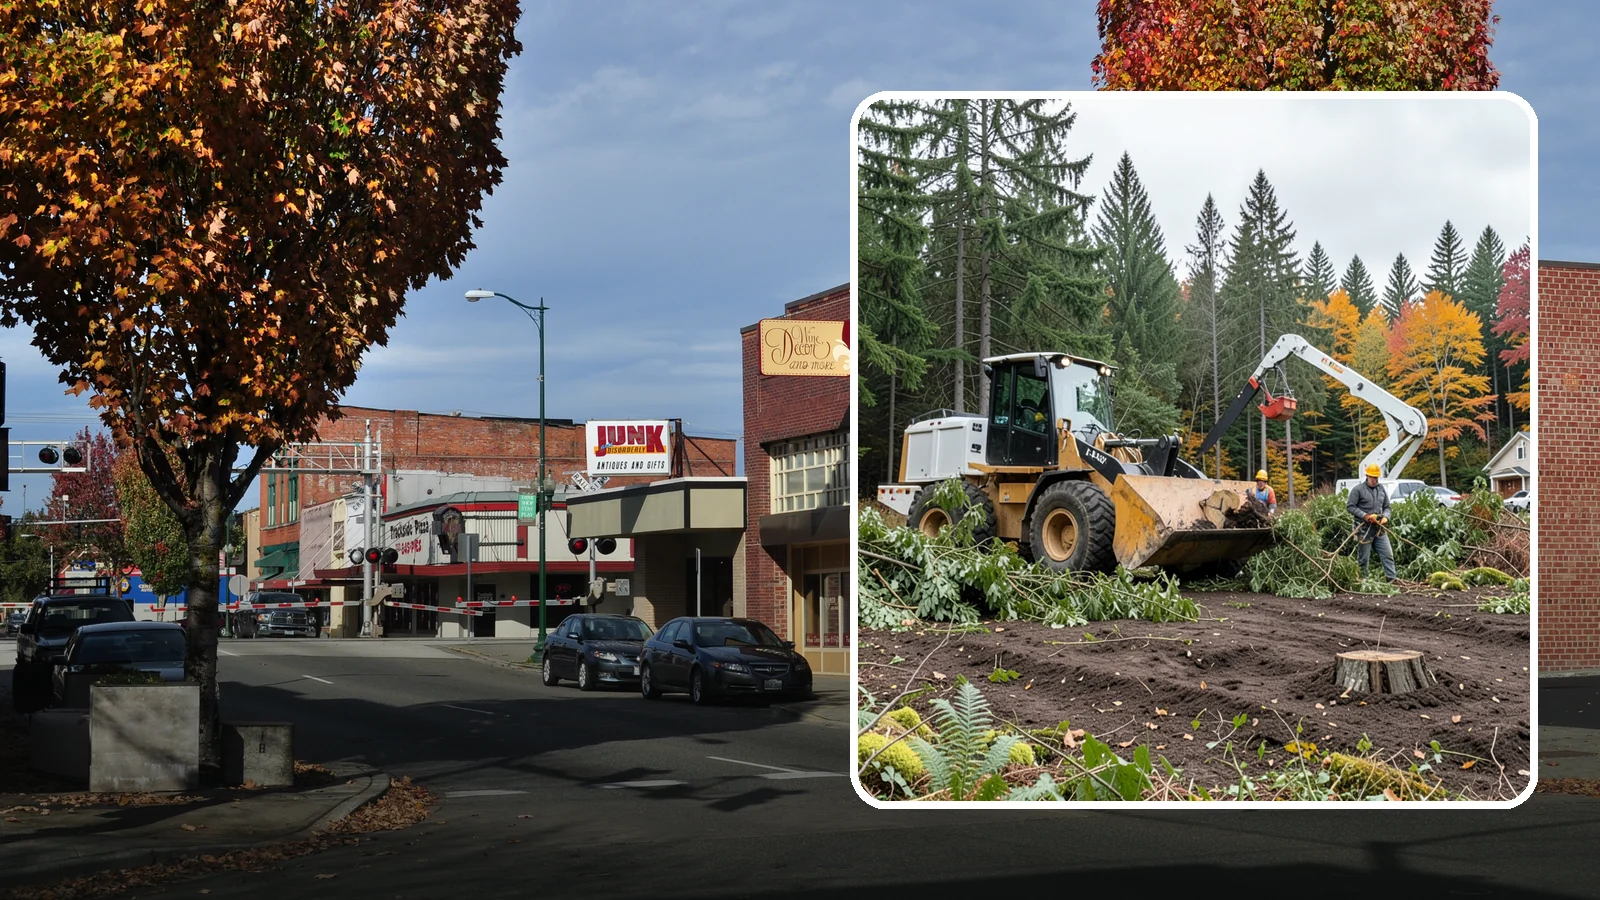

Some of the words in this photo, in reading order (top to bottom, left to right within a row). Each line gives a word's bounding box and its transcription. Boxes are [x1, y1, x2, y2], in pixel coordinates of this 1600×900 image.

[595, 425, 665, 457] JUNK
[607, 446, 646, 454] DISORDERLY
[596, 461, 628, 470] ANTIQUES
[630, 461, 644, 469] AND
[646, 460, 665, 469] GIFTS
[414, 519, 429, 535] Pizza
